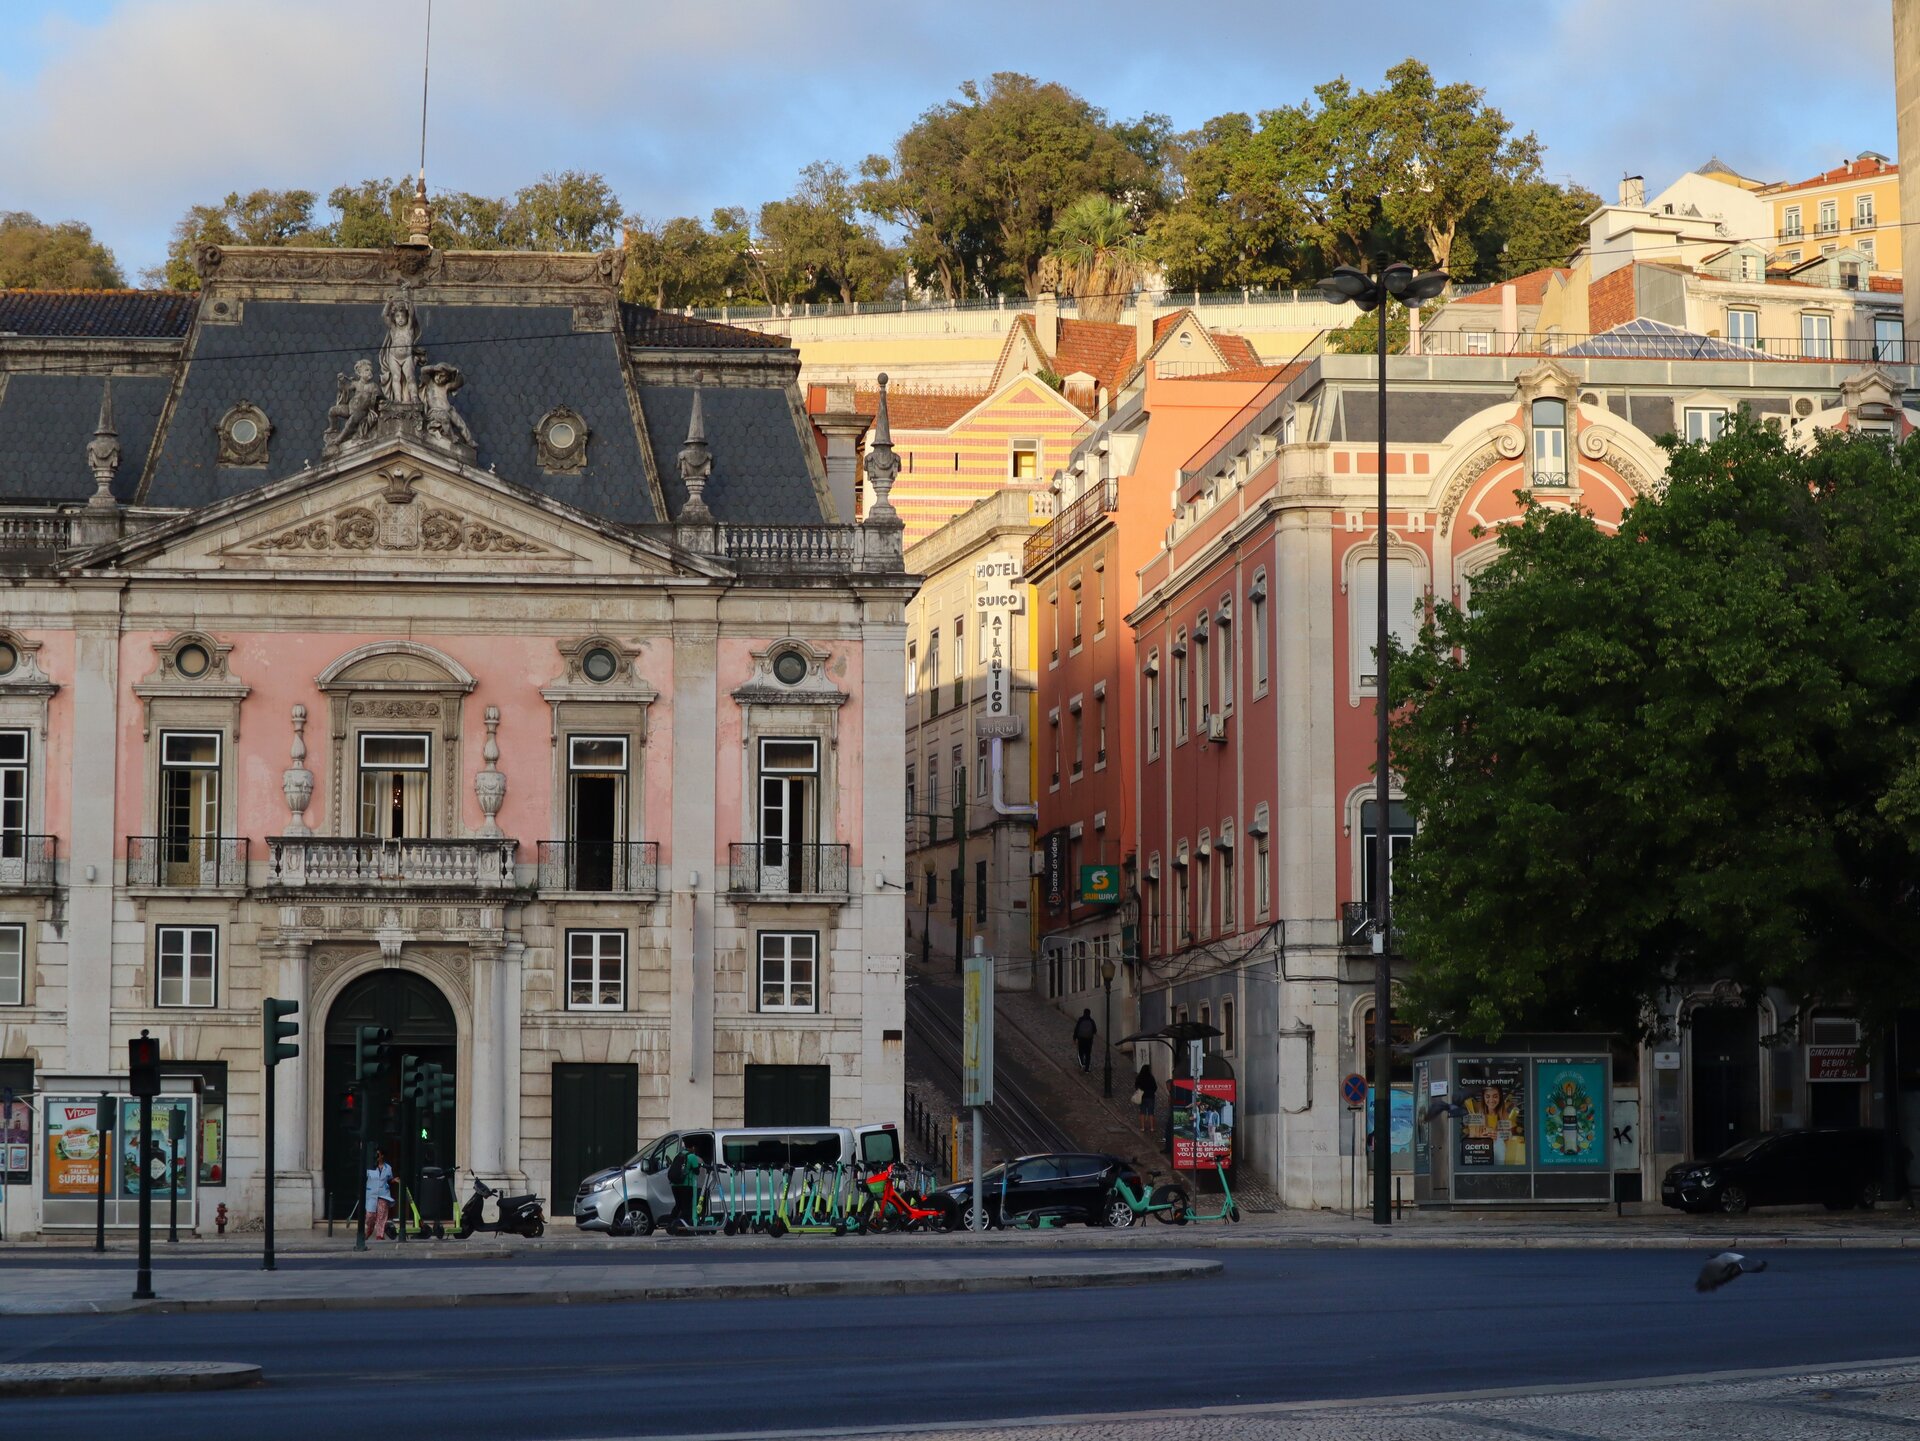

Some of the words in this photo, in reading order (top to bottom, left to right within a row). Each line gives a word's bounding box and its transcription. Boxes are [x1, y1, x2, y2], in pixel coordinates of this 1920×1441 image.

[977, 563, 1018, 577] HOTEL
[977, 595, 1017, 607] SUIÇO
[991, 615, 1002, 713] ATLÂNTICO
[981, 726, 1014, 735] TURIM
[1051, 859, 1058, 869] do
[1486, 1078, 1515, 1086] ganhar?
